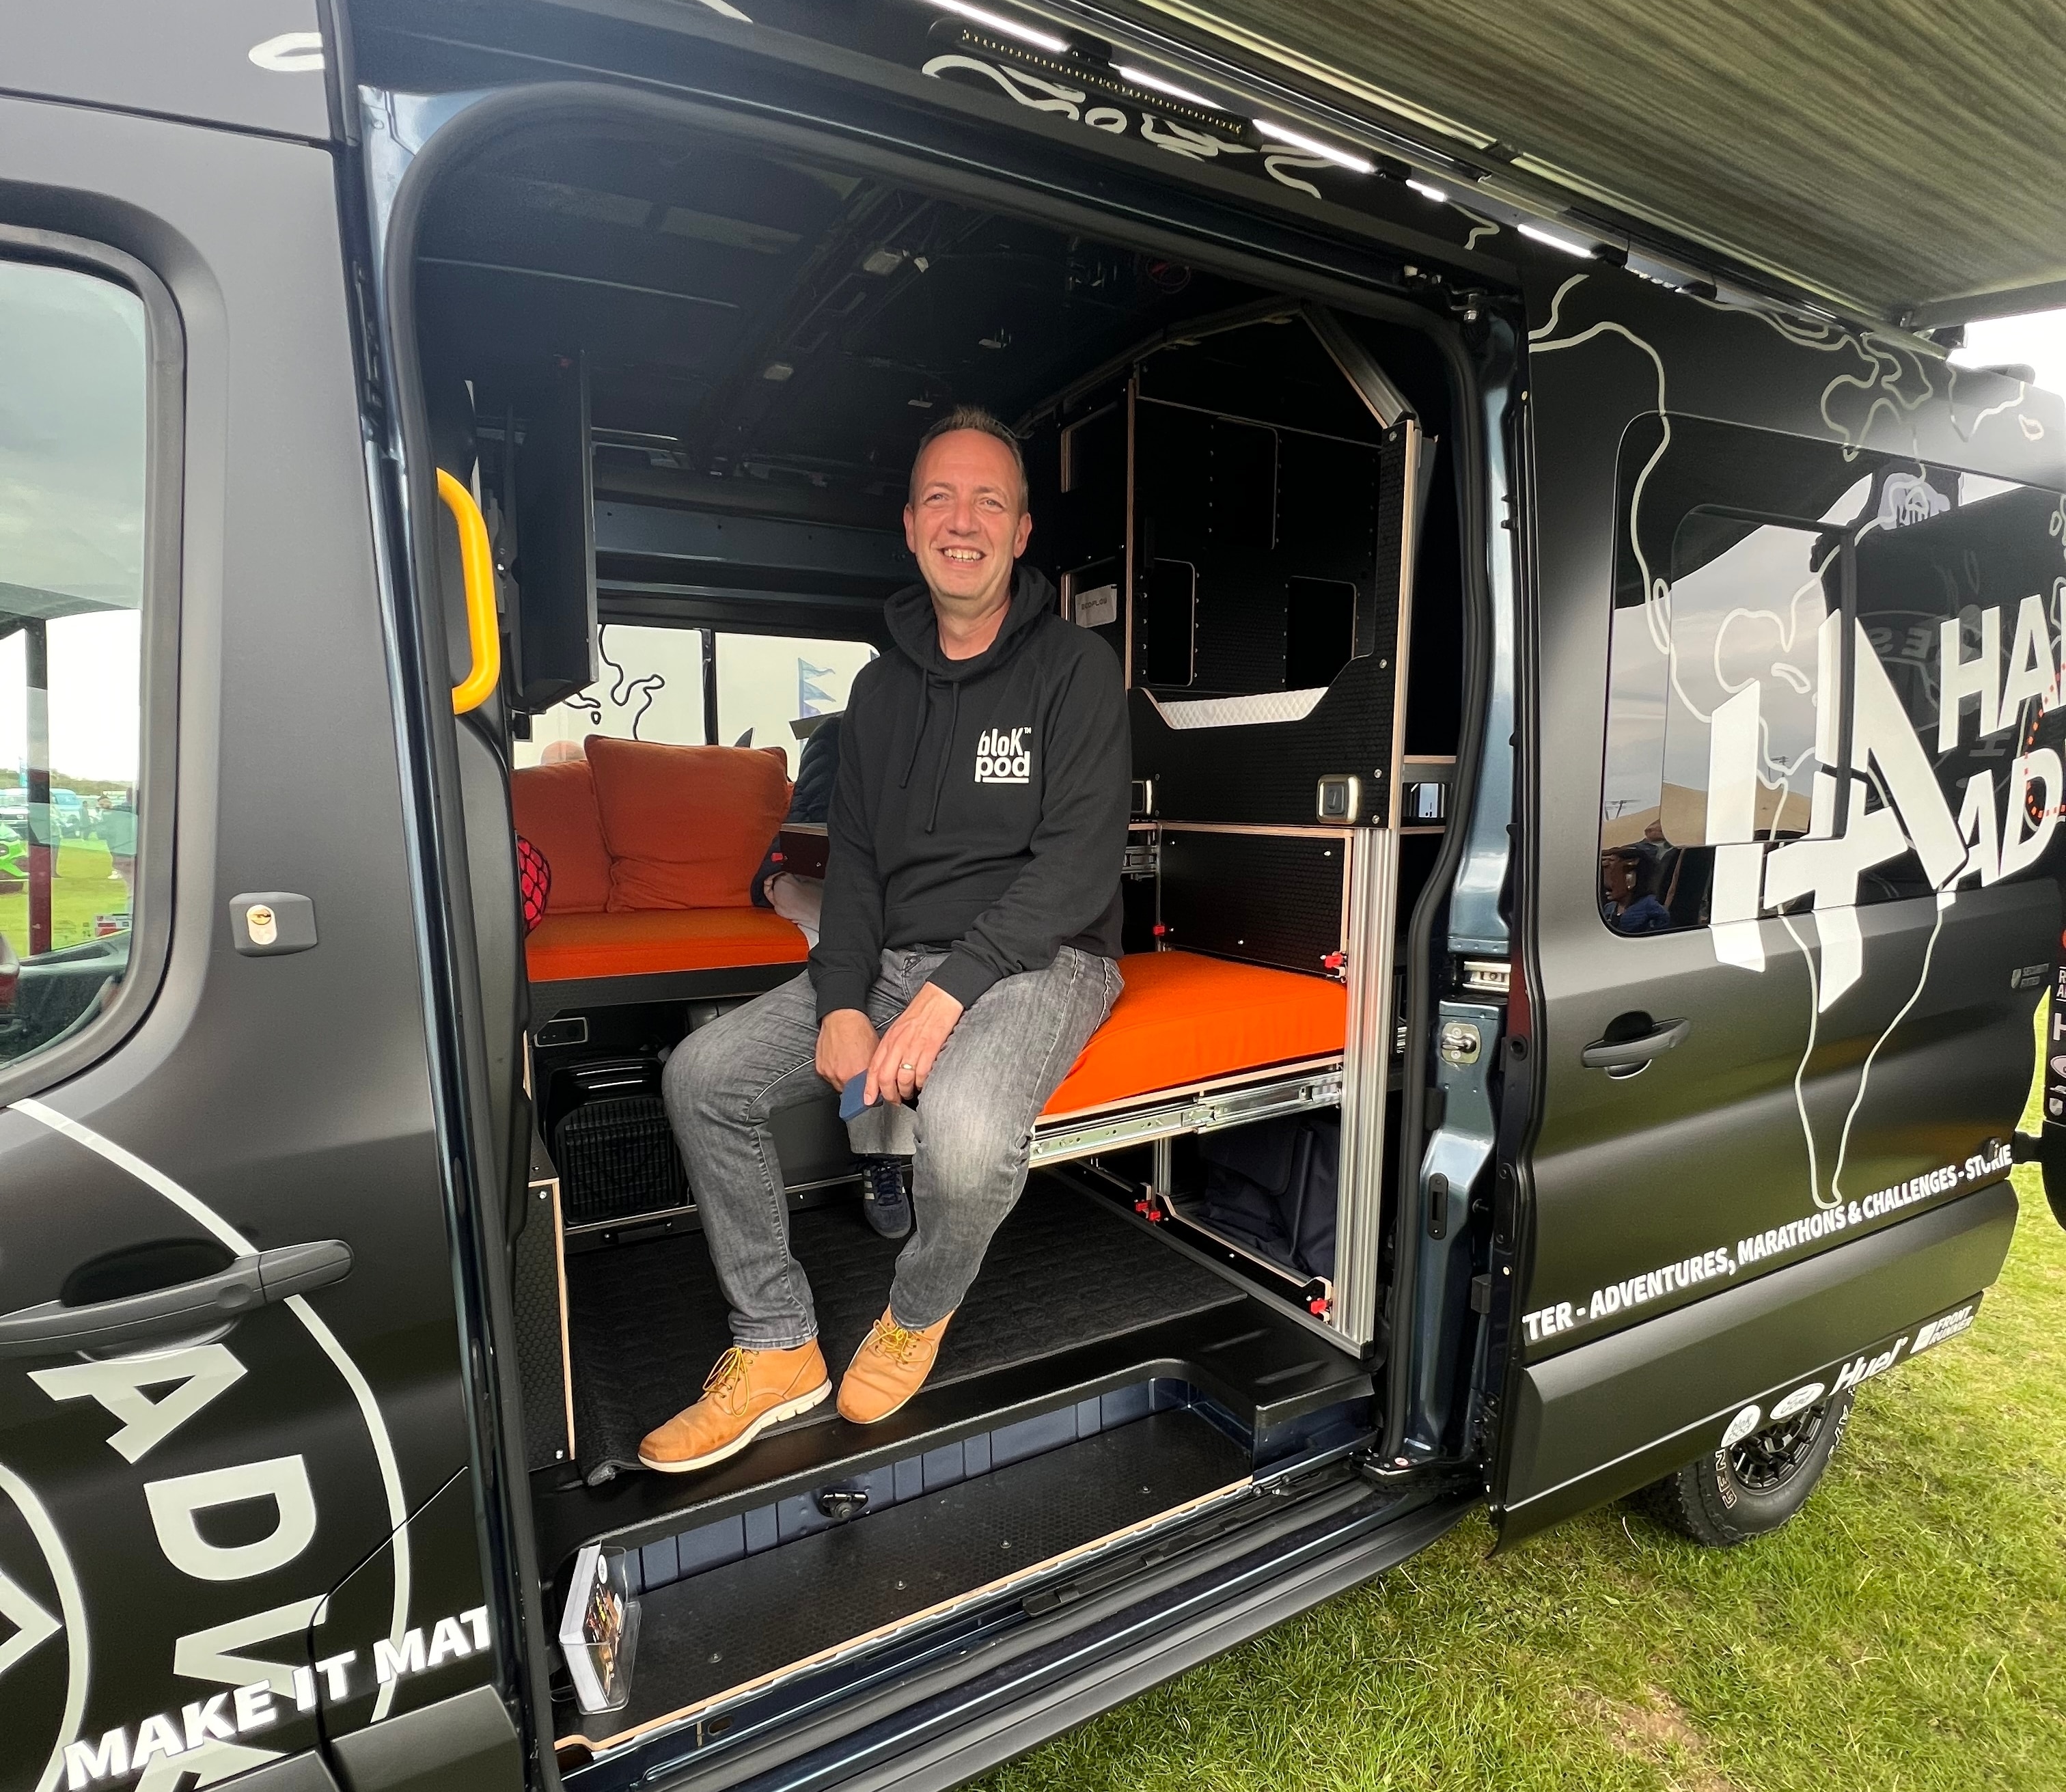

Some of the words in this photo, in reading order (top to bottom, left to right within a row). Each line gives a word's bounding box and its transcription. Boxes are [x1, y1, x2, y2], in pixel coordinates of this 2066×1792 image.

[974, 751, 1030, 783] pod
[1590, 1247, 1736, 1319] ADVENTURES,
[1737, 1205, 1846, 1265] MARATHONS
[1847, 1201, 1862, 1225] &
[1862, 1165, 1957, 1219] CHALLENGES
[1928, 1316, 1974, 1345] RUNNER
[1935, 1305, 1973, 1332] FRONT
[63, 1679, 276, 1791] MAKE
[292, 1649, 356, 1711] IT
[373, 1605, 491, 1684] MAT
